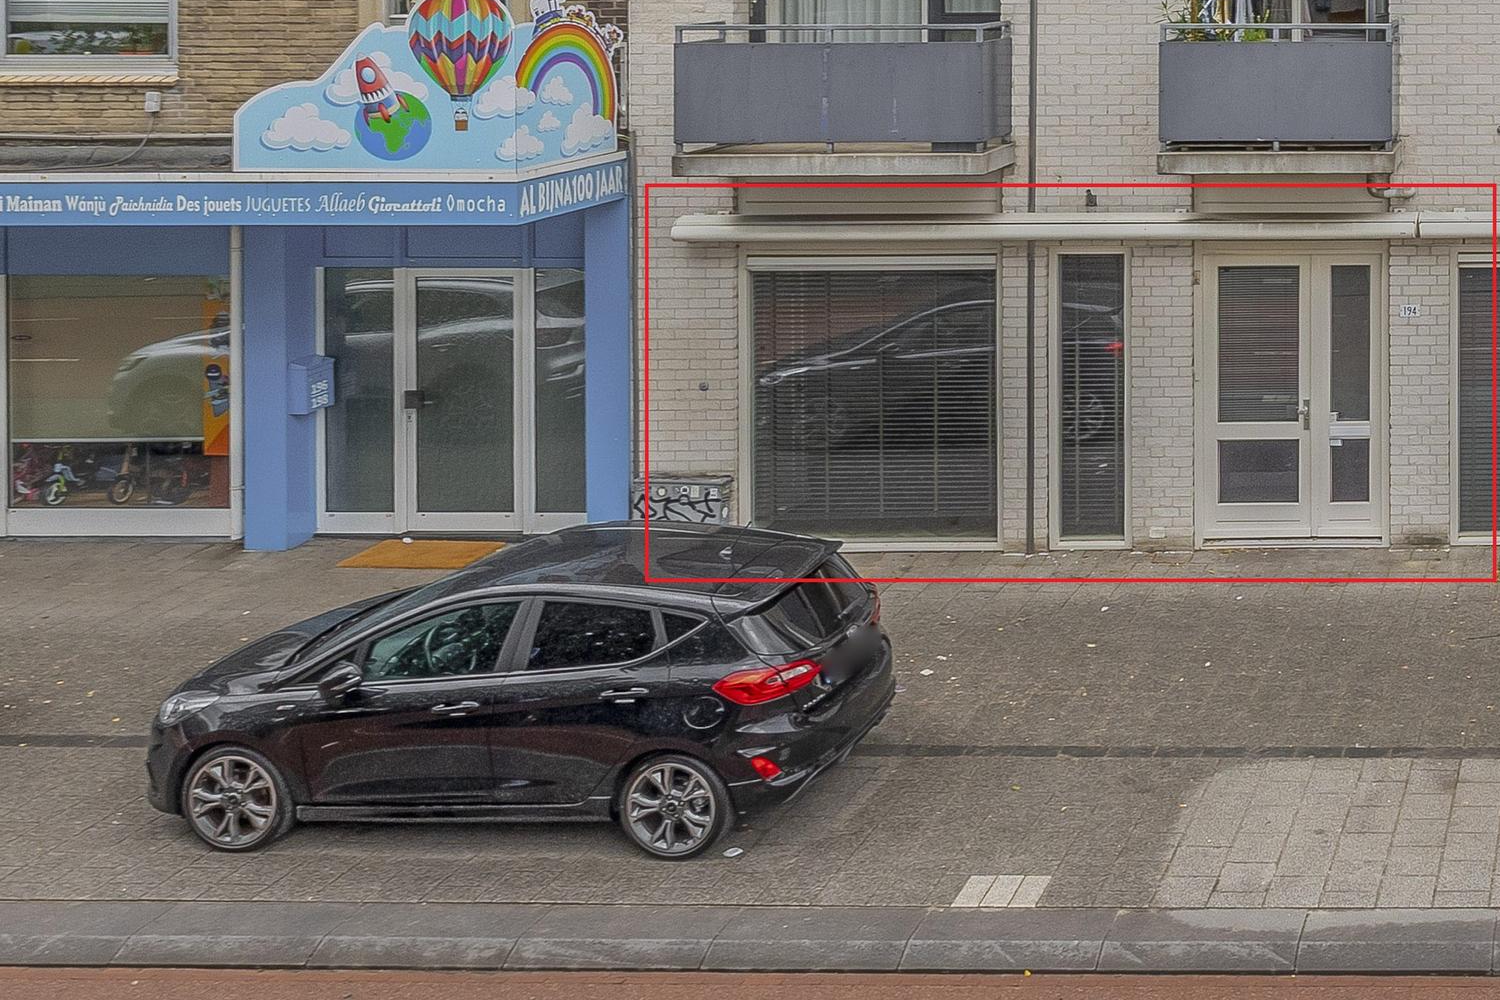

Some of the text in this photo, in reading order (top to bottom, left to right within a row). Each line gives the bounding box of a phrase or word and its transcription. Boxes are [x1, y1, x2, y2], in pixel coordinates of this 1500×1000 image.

[520, 184, 537, 218] AL
[538, 177, 573, 213] BIJNA
[595, 165, 623, 202] JAAR
[6, 195, 63, 212] Mainan
[176, 195, 200, 212] Des
[203, 196, 242, 216] jouets
[245, 195, 311, 212] JUGUETES
[315, 192, 366, 212] Allaeb
[368, 195, 443, 214] Giocattoli
[447, 194, 506, 212] Omocha
[1403, 306, 1417, 316] 194
